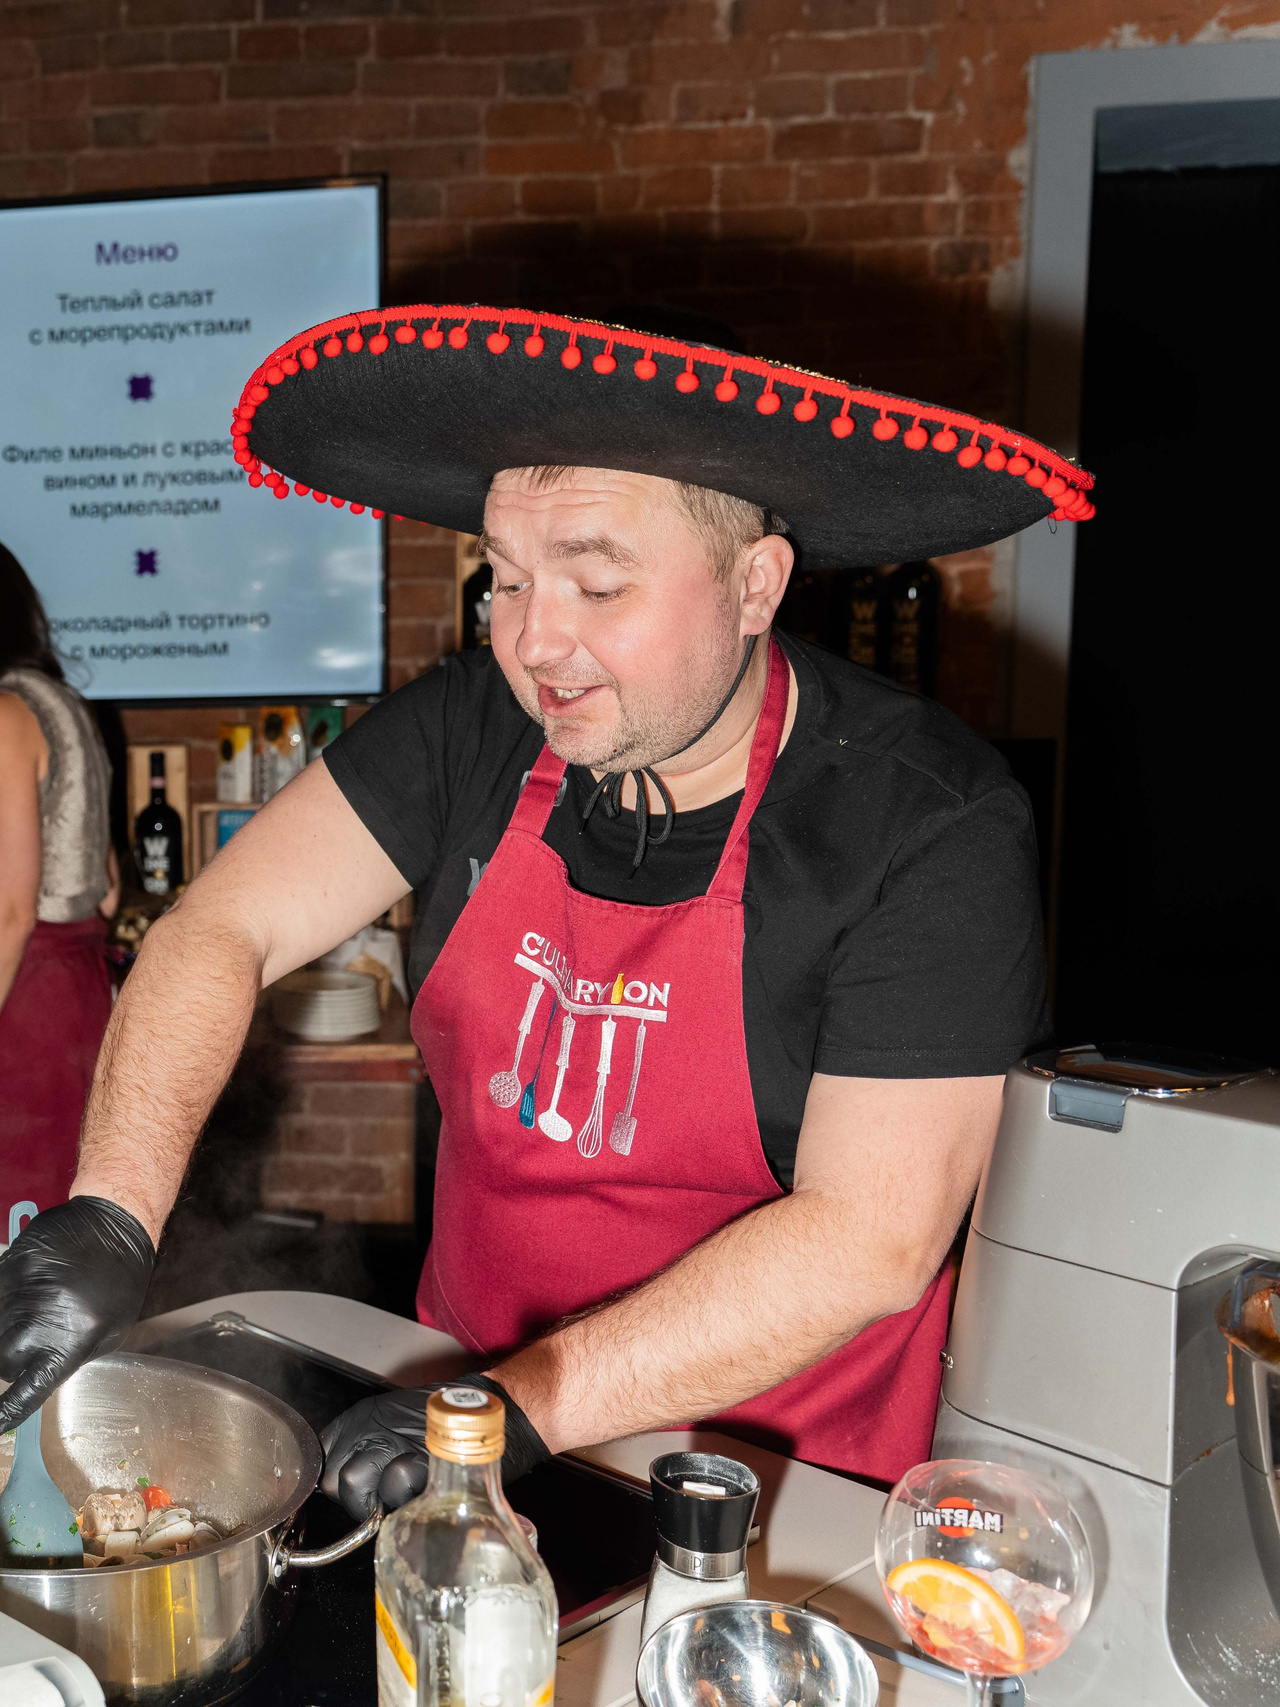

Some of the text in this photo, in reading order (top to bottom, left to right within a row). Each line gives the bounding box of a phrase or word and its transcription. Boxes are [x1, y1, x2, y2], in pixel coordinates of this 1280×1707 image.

[96, 241, 179, 266] Меню
[56, 288, 216, 315] Теплый салат
[29, 318, 252, 347] с морепродуктами
[2, 438, 233, 465] Филе миньон с крас
[43, 467, 246, 493] вином и луковым
[70, 497, 221, 521] мармеладом
[48, 610, 270, 638] околадный тортино
[70, 640, 229, 662] с мороженым
